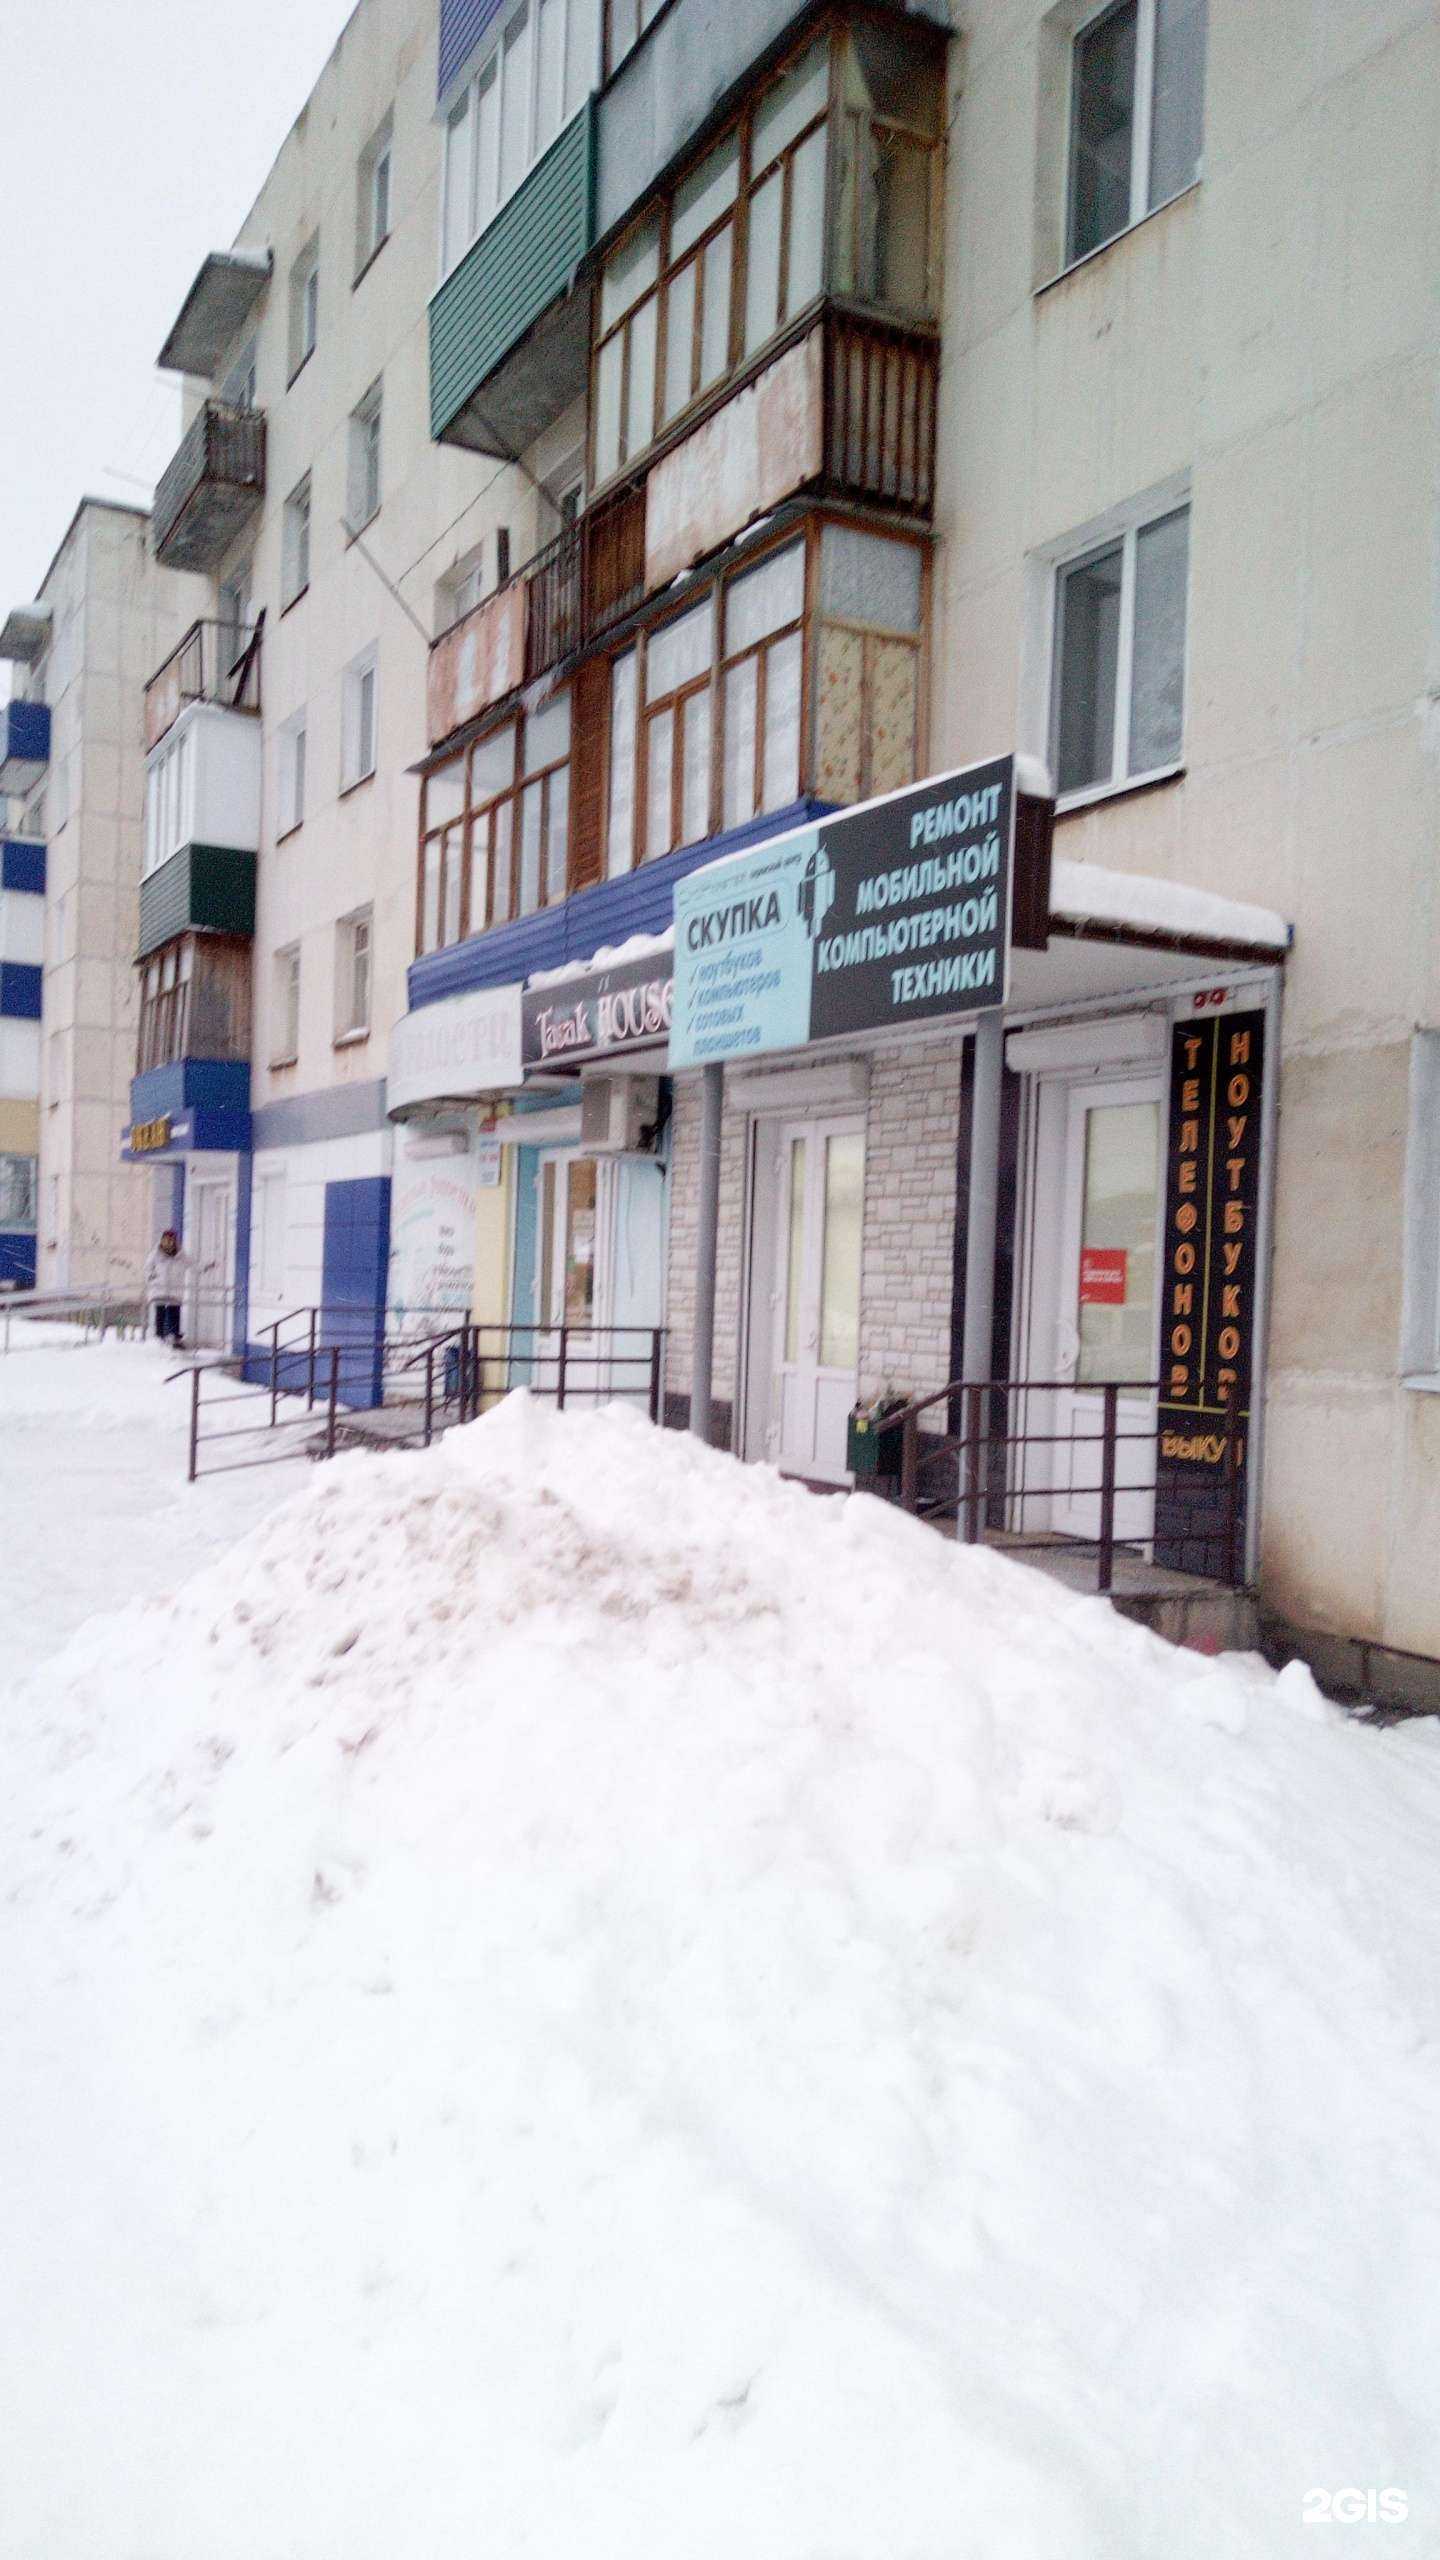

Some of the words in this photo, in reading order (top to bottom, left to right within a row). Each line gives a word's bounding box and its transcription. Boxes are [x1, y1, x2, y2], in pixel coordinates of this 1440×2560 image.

[910, 782, 1003, 850] РЕМОНТ
[855, 830, 1001, 916] МОБИЛЬНОЙ
[687, 890, 781, 951] СКУПКА
[816, 885, 999, 974] КОМПЬЮТЕРНОЙ
[890, 948, 996, 1005] ТЕХНИКИ
[1169, 1037, 1202, 1397] ТЕЛЕФОНОВ
